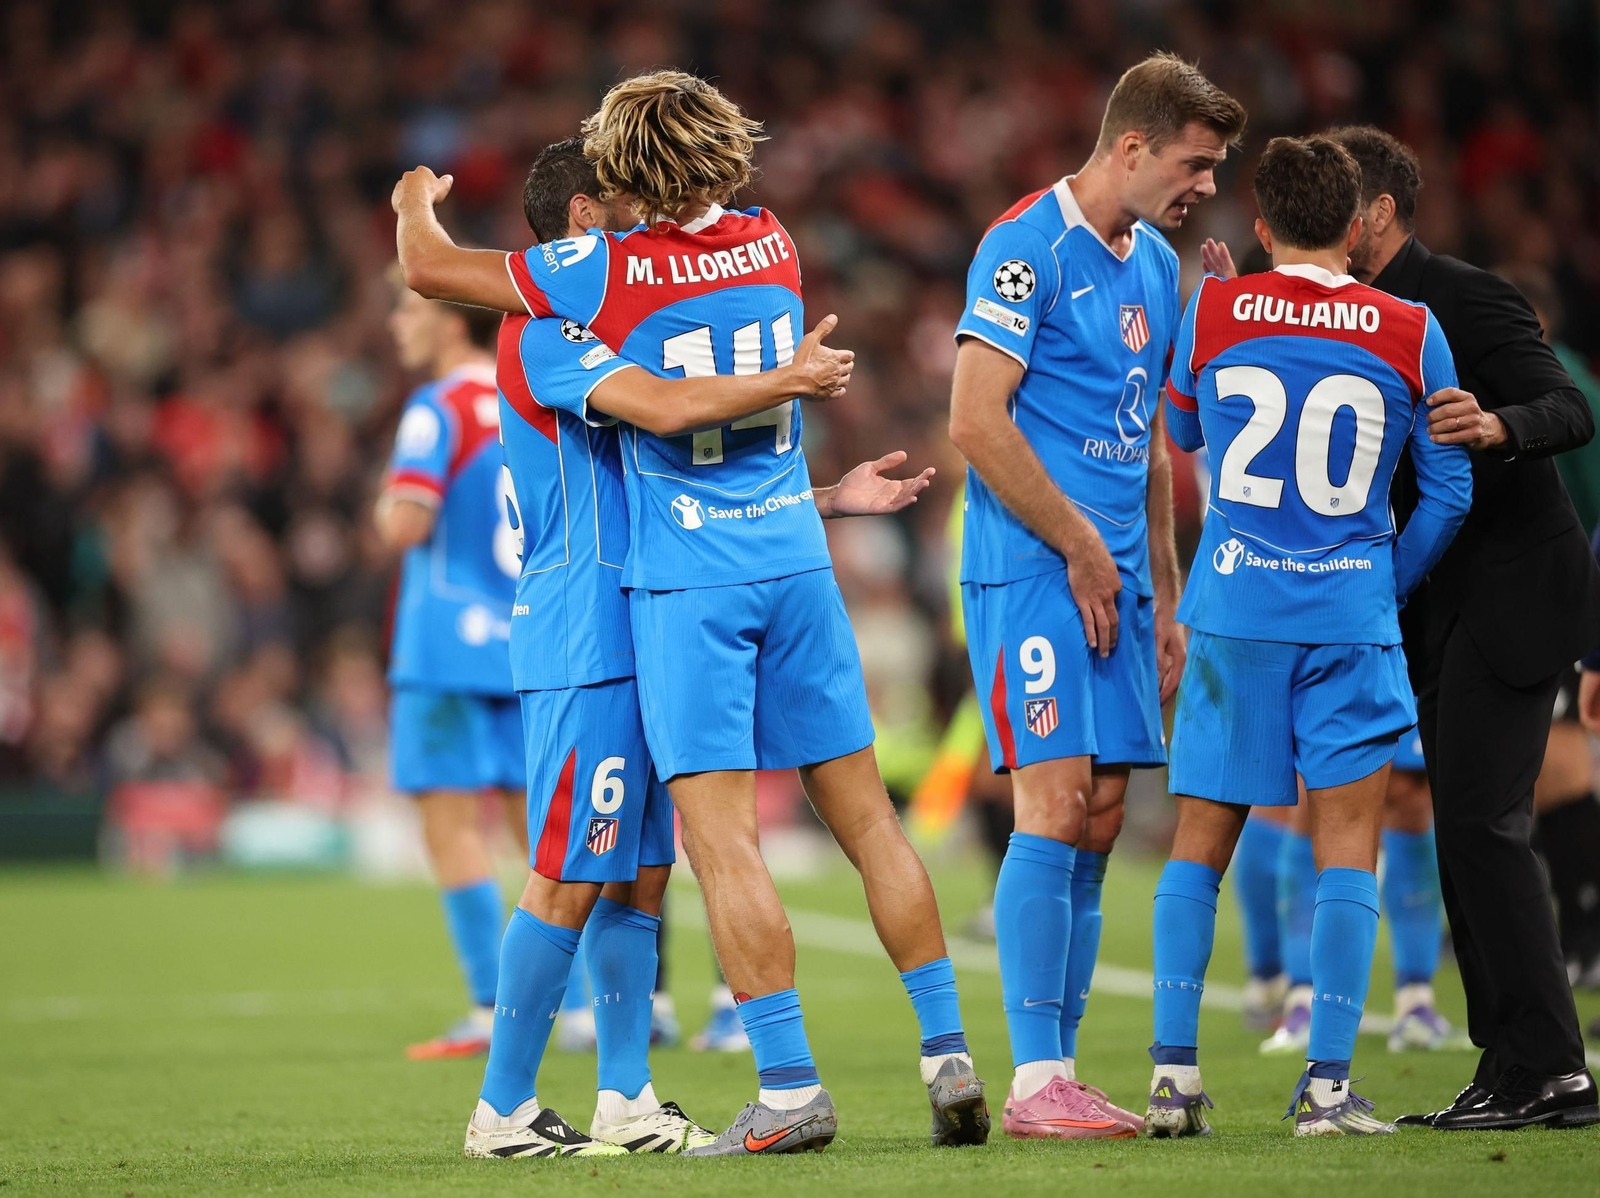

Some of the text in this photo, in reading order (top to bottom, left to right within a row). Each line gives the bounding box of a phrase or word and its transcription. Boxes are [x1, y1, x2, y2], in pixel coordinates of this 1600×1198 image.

[625, 231, 790, 285] M. LLORENTE
[1232, 293, 1381, 333] GIULIANO
[662, 311, 796, 466] 14
[1213, 365, 1387, 517] 20
[707, 489, 815, 519] Save the Children
[1245, 552, 1372, 573] Save the Children
[1019, 635, 1057, 694] 9
[590, 756, 626, 815] 6
